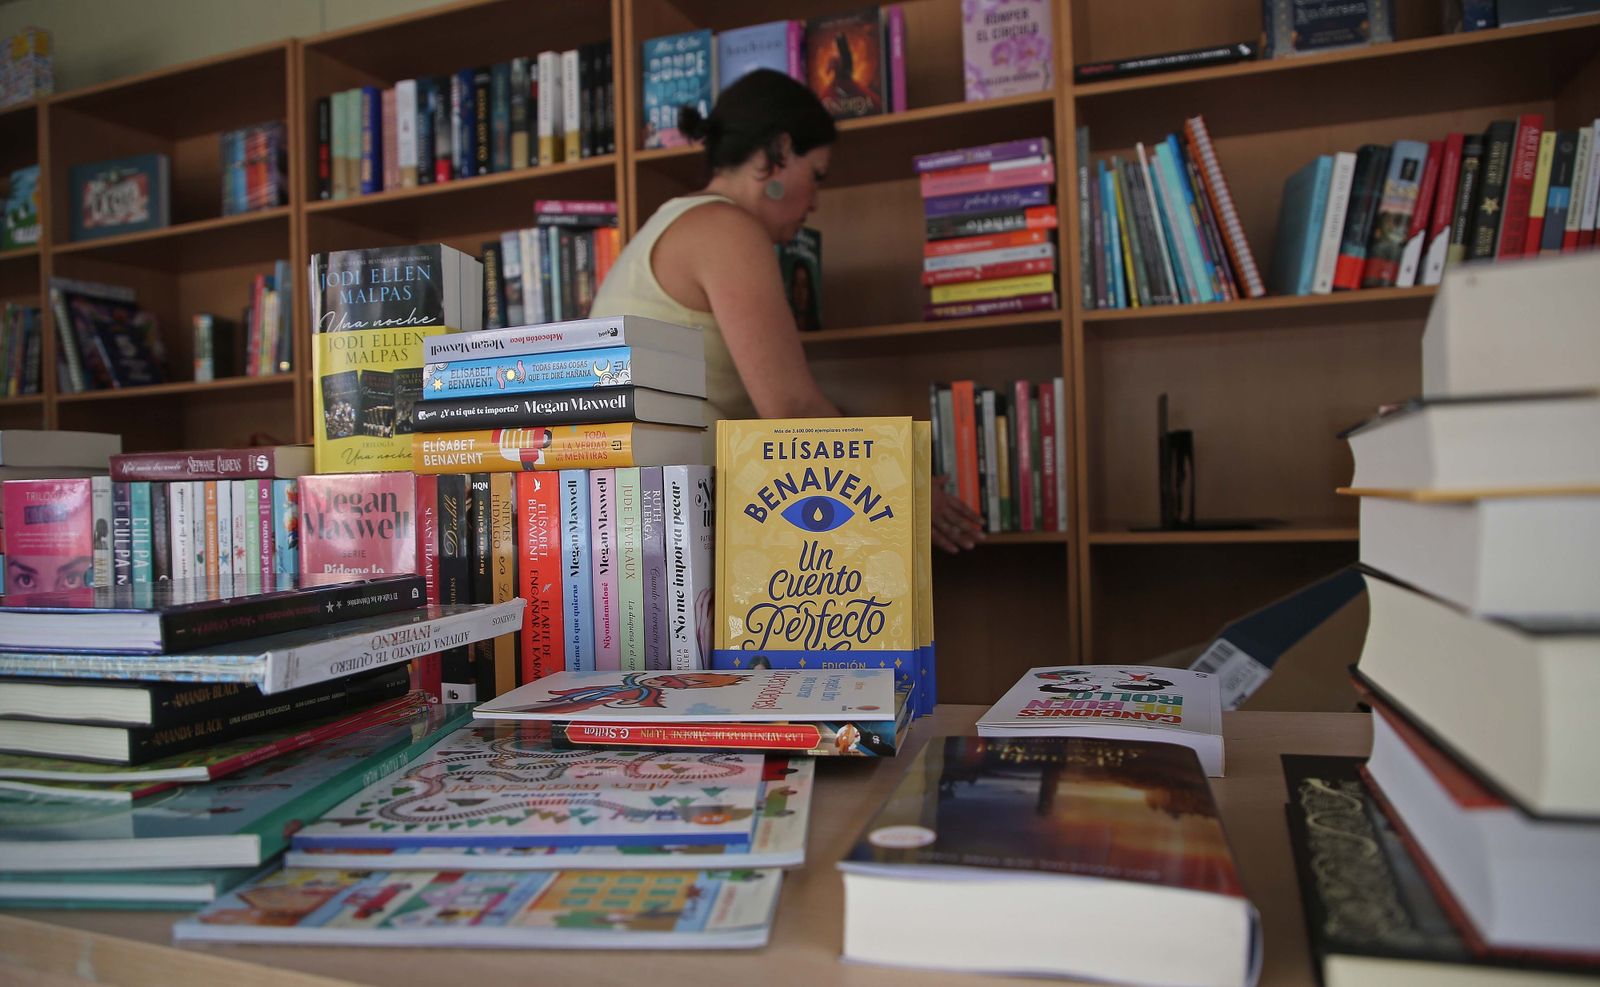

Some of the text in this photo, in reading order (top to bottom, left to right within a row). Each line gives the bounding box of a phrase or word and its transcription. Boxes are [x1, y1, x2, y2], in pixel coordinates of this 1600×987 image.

[321, 264, 432, 291] JODI ELLEN
[340, 284, 413, 304] MALPAS
[320, 307, 437, 333] Una noche
[329, 332, 426, 352] JODI ELLEN
[431, 338, 505, 356] Megan Maxwell
[509, 331, 564, 345] Melocotón loco
[345, 348, 409, 364] MALPAS
[532, 360, 588, 371] TODAS ESAS COSAS
[449, 377, 494, 390] BENAVENT
[450, 366, 491, 379] ELÍSABET
[529, 368, 592, 381] QUE TE DIRÉ MAÑANA
[440, 409, 449, 419] ¿Y
[456, 408, 462, 416] ti
[462, 407, 476, 418] qué
[477, 406, 484, 415] te
[485, 404, 519, 415] importa?
[524, 395, 627, 415] Megan Maxwell
[423, 437, 476, 452] ELÍSABET
[562, 441, 608, 450] LA VERDAD
[584, 431, 607, 439] TODA
[341, 447, 413, 465] Una noche
[424, 452, 483, 467] BENAVENT
[564, 451, 608, 461] MENTIRAS
[763, 438, 874, 460] ELÍSABET
[261, 488, 269, 499] 3
[472, 481, 489, 491] HQN
[743, 466, 894, 524] BENAVENT
[308, 487, 398, 517] Megan
[652, 490, 661, 522] RUTH
[303, 511, 410, 541] Maxwell
[442, 494, 459, 559] Diablo
[492, 494, 502, 550] HIDALGO
[501, 500, 511, 543] NIEVES
[527, 499, 538, 562] BENAVENT
[537, 503, 549, 557] ELÍSABET
[567, 480, 581, 577] Megan Maxwell
[597, 477, 609, 576] Megan Maxwell
[621, 484, 636, 580] JUDE DEVERAUX
[113, 517, 131, 568] CULPA
[132, 517, 149, 568] CULPA
[342, 549, 367, 559] SERIE
[478, 539, 486, 576] Mercedes
[671, 481, 688, 643] No me importa pecar
[799, 540, 833, 572] Un
[768, 565, 863, 601] Cuento
[602, 582, 611, 649] Niyomismalosé
[628, 600, 635, 609] La
[650, 567, 661, 643] Cuando el corazón
[529, 569, 542, 682] ENGAÑAR AL KARM
[541, 600, 551, 657] EL ARTE DE
[571, 584, 582, 671] ídeme lo que quieras
[627, 611, 636, 642] duquesa
[742, 596, 893, 650] Perfecto
[371, 624, 431, 651] INVIERNO
[434, 630, 471, 649] ADIVINA
[329, 652, 374, 675] QUIERO
[375, 651, 389, 664] TE
[629, 649, 636, 657] el
[822, 659, 866, 669] EDICIÓN
[173, 682, 239, 708] AMANDA BLACK
[1068, 691, 1184, 706] ROLLO
[229, 704, 291, 725] UNA HERENCIA PELIGROSA
[1016, 708, 1183, 725] CANCIONES
[1025, 699, 1184, 715] DE BUEN
[153, 719, 223, 746] AMANDA BLACK
[640, 729, 804, 742] LAS AVENTURAS DE LUPIN
